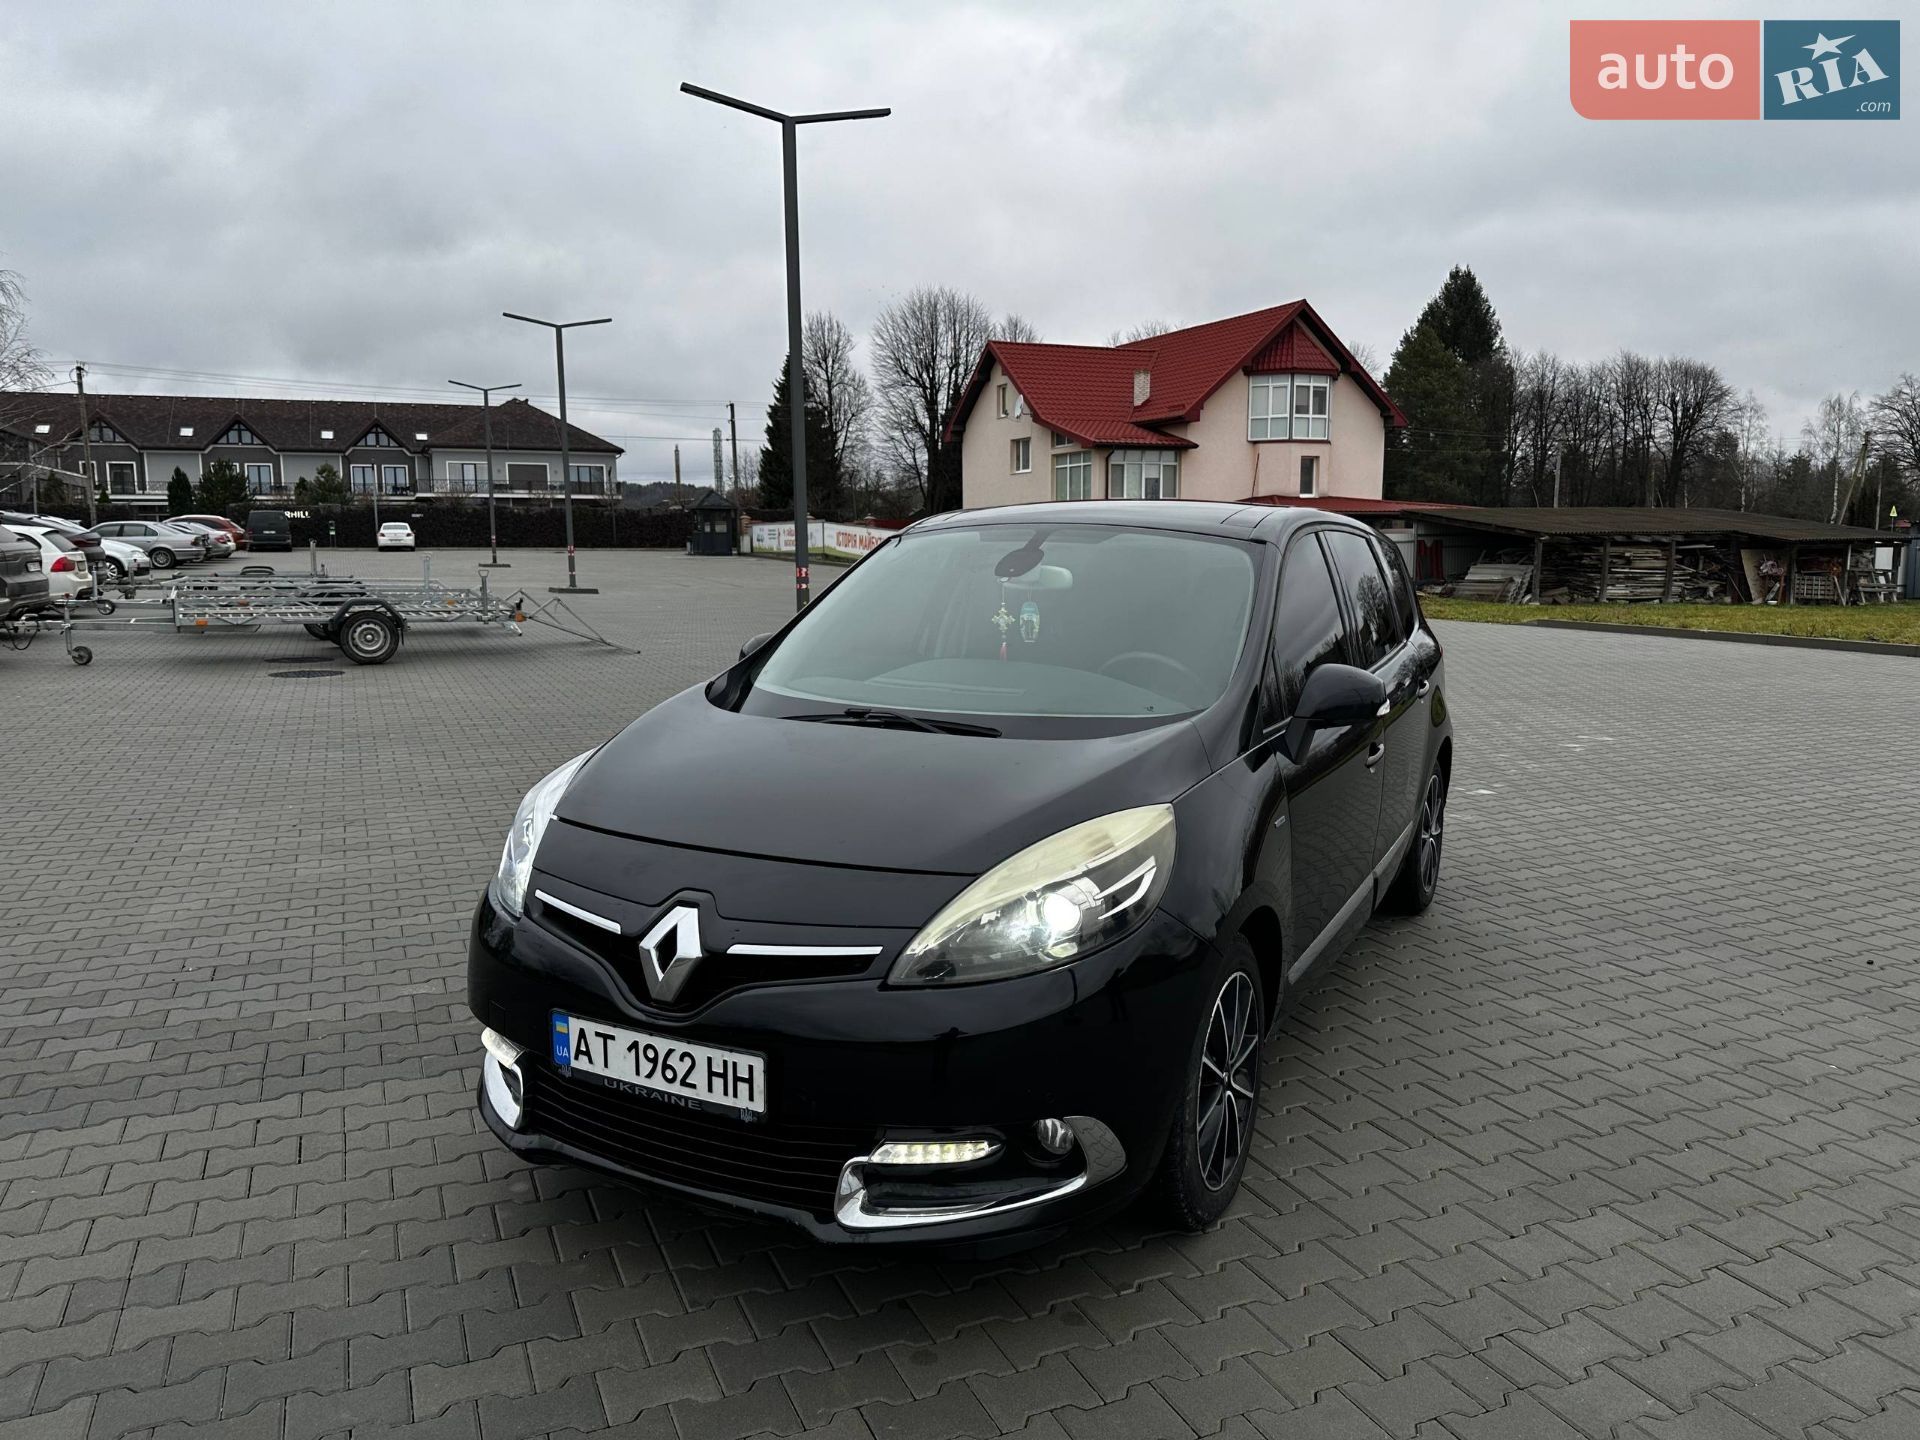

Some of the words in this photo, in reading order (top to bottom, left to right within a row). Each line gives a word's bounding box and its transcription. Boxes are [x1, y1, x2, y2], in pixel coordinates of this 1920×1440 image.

[556, 1045, 570, 1058] UA
[573, 1027, 616, 1069] AT
[626, 1039, 697, 1090] 1962
[706, 1055, 755, 1103] HH
[602, 1077, 702, 1111] UKRAINE
